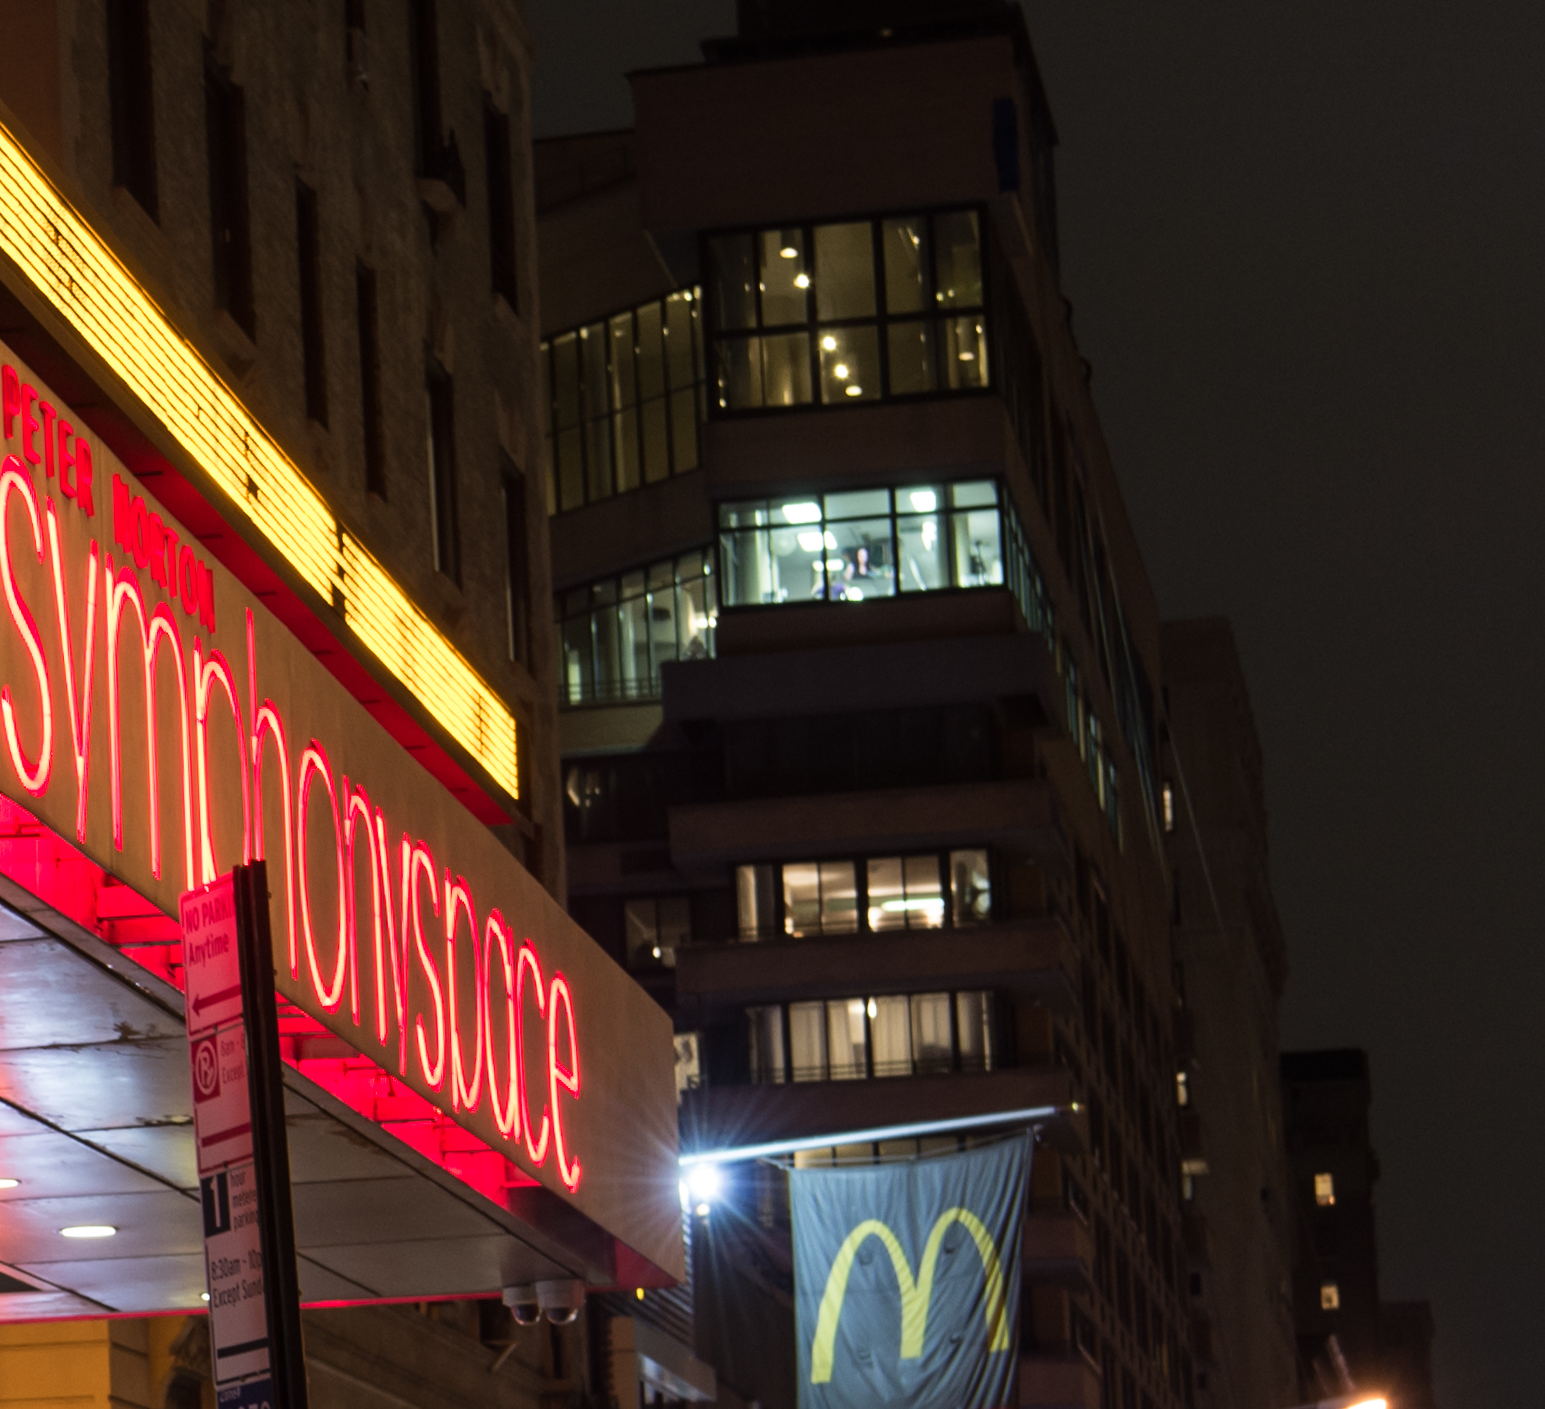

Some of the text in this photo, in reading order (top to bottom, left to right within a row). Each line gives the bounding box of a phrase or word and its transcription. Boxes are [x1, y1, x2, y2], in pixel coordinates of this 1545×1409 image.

[1, 363, 216, 633] PETER NORTON
[185, 894, 236, 935] NO PARKI
[188, 933, 230, 967] Anytime
[210, 1174, 221, 1228] 1
[231, 1187, 257, 1209] metere
[232, 1209, 259, 1232] parkin
[212, 1277, 264, 1308] Except Sund
